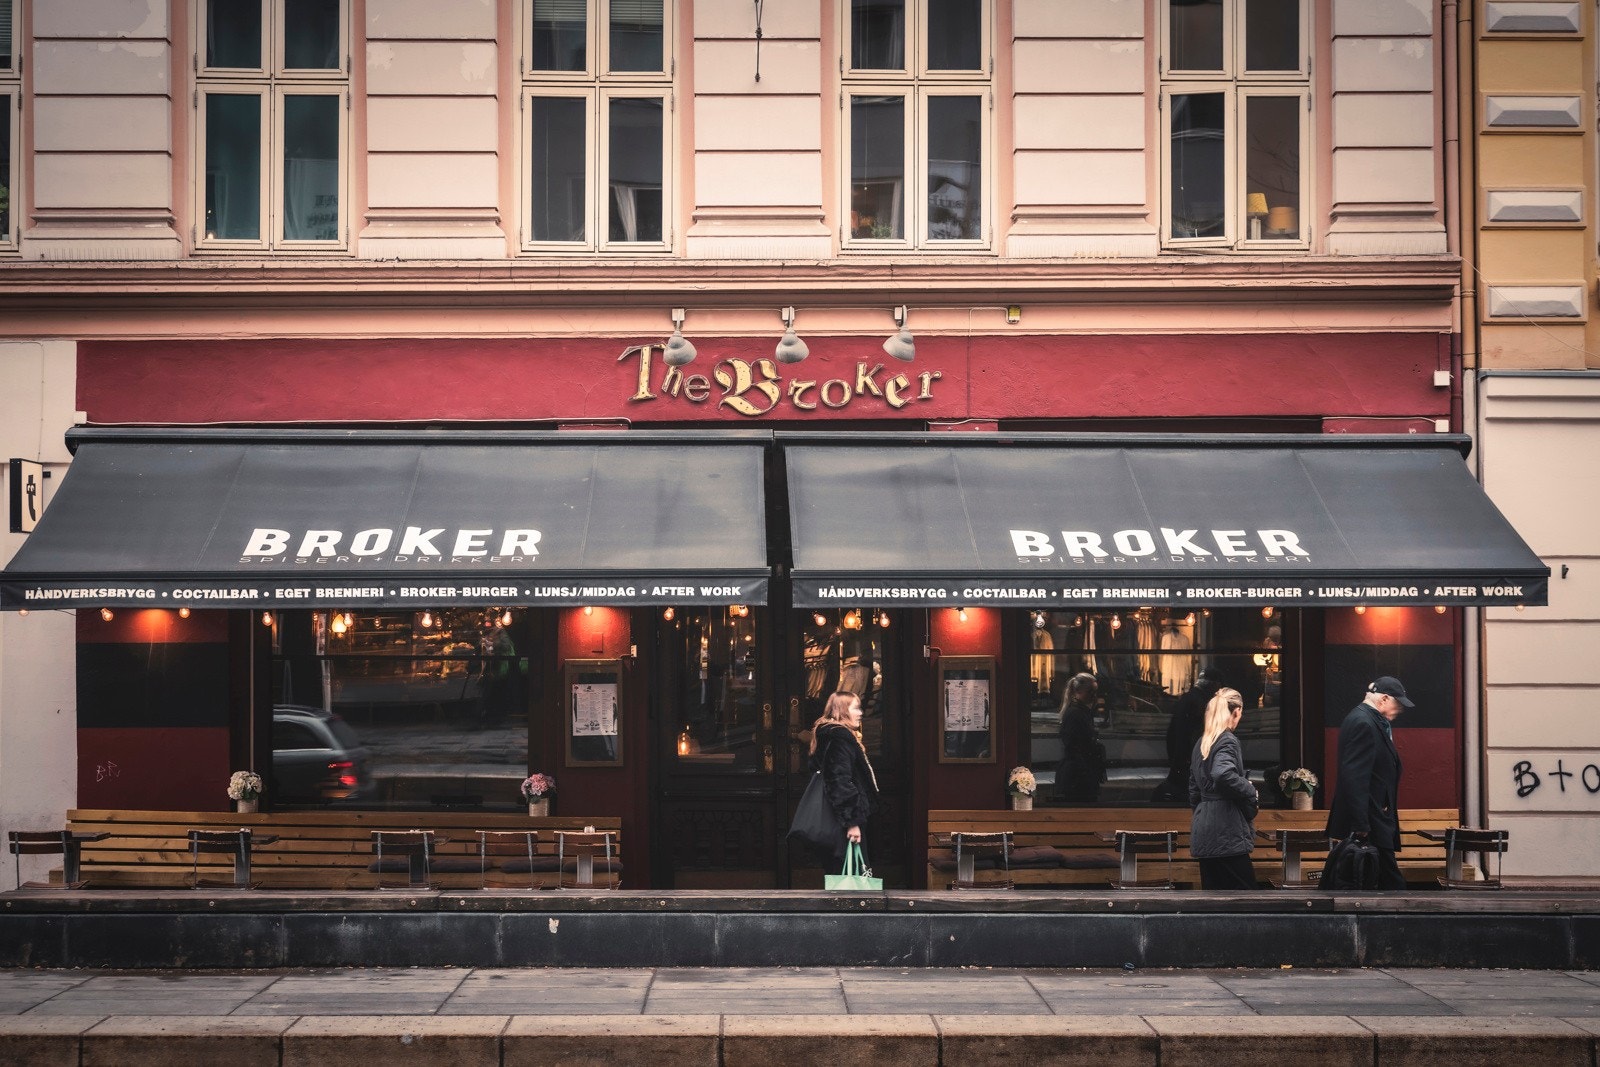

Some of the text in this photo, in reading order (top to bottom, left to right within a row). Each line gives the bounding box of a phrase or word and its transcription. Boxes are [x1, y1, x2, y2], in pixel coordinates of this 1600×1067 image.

[617, 343, 710, 402] The
[242, 526, 542, 557] BROKER
[1009, 527, 1310, 557] BROKER
[25, 586, 742, 600] HÅNDVERKSBRYGG COCTAILBAR EGET BRENNERI BROKER-BURGER LUNSJ/MIDDAG AFTER WORK
[818, 585, 1524, 598] HÅNDVERKSBRYGG COCTAILBAR EGET BRENNERI BROKER-BURGER LUNSJ/MIDDAG AFTER WORK
